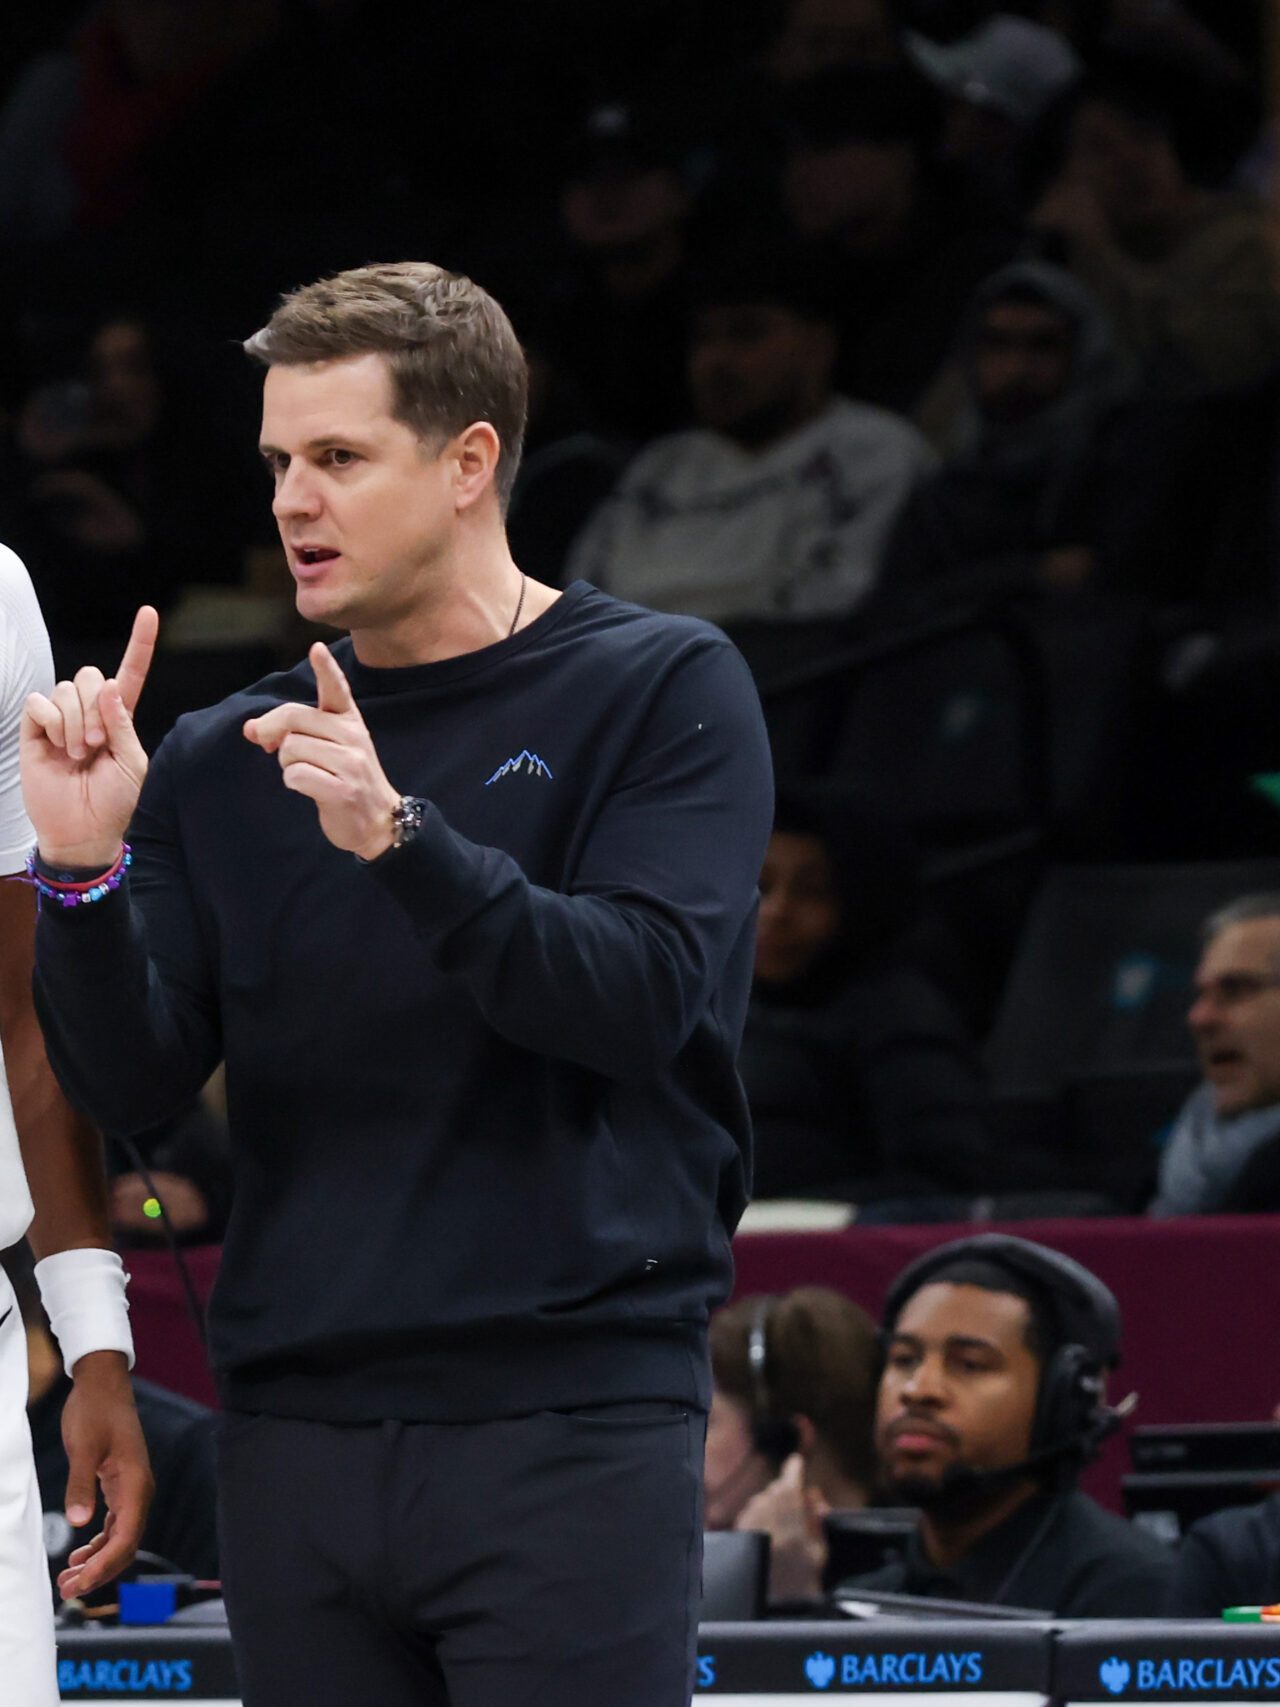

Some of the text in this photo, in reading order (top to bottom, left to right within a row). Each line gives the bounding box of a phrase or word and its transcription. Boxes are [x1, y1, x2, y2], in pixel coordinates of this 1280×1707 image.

[58, 1659, 192, 1691] BARCLAYS
[840, 1653, 983, 1685] BARCLAYS
[1137, 1657, 1280, 1690] BARCLAYS
